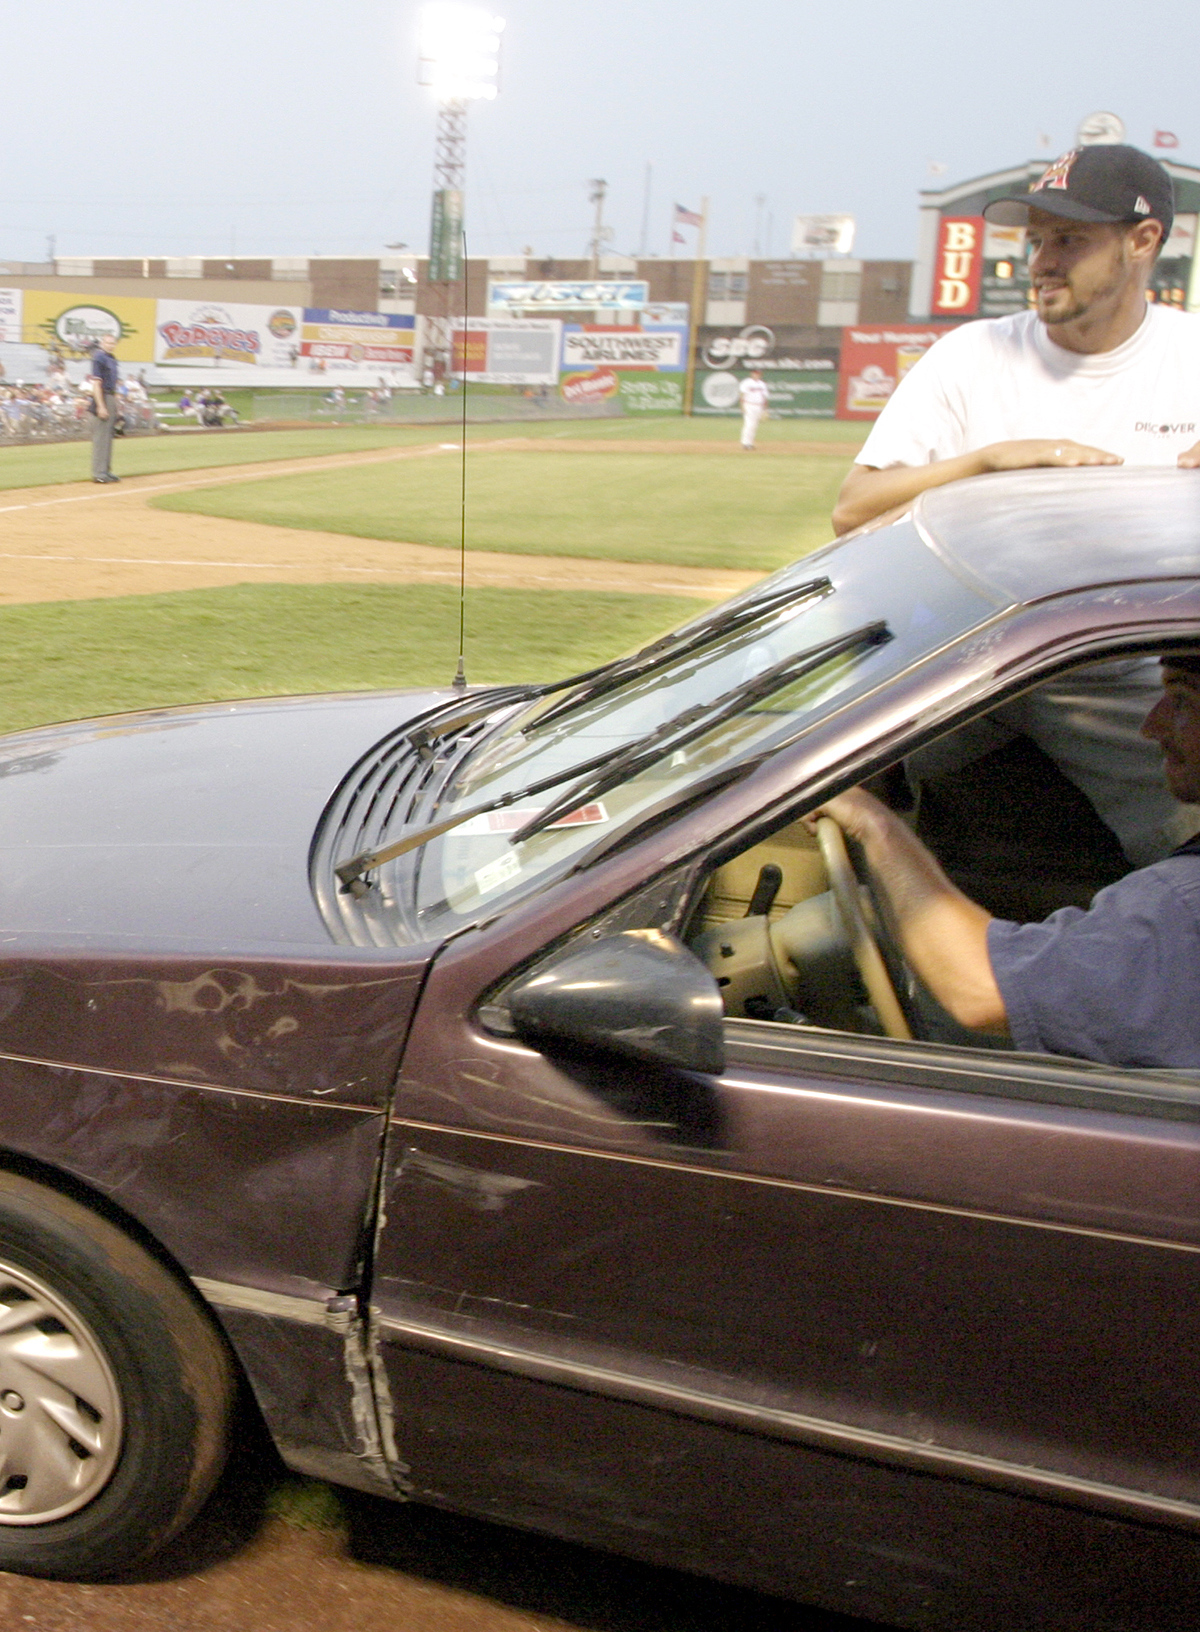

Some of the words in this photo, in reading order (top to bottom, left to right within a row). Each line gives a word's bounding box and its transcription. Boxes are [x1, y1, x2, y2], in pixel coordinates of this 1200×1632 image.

[937, 222, 976, 308] BUD
[328, 309, 390, 328] Productivity
[566, 336, 677, 350] SOUTHWEST
[850, 331, 881, 344] Your
[580, 349, 661, 362] AIRLINES
